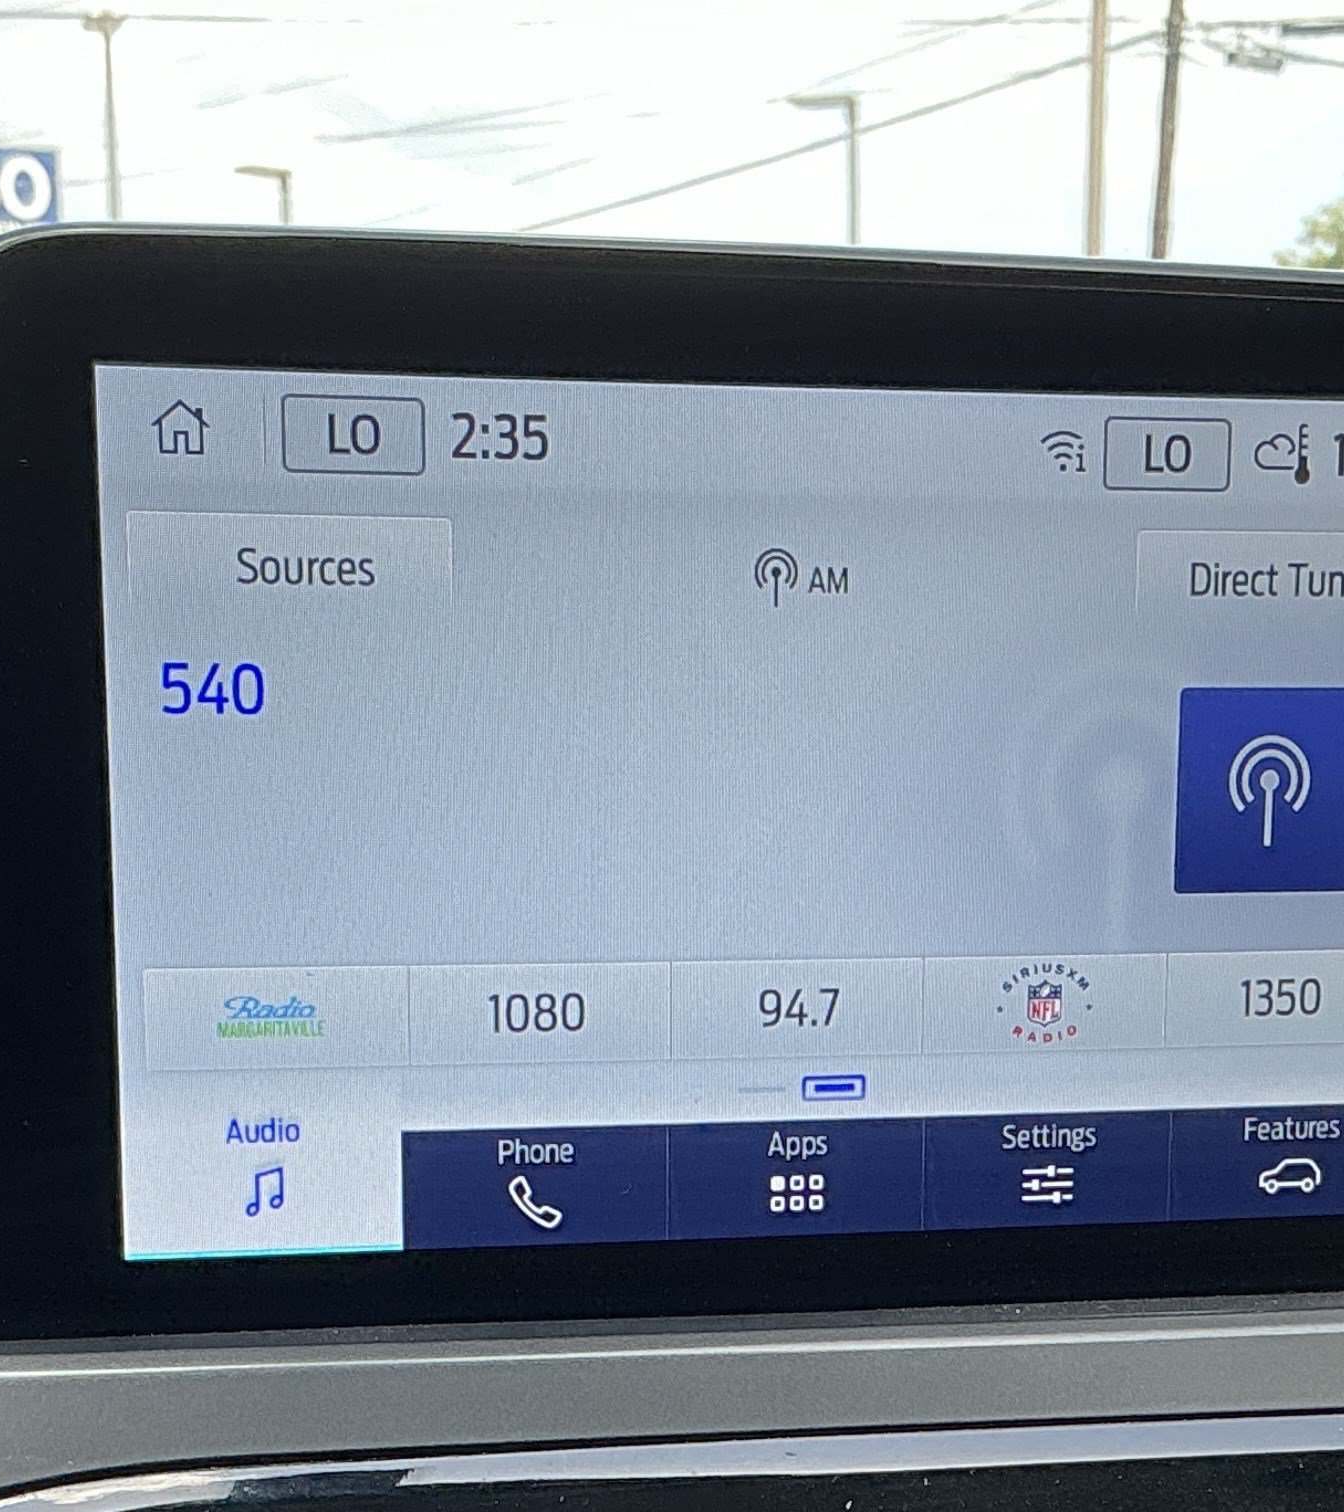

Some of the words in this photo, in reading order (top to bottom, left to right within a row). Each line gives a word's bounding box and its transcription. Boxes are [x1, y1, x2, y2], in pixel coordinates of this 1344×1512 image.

[327, 412, 381, 456] LO
[451, 412, 549, 461] 2:35
[1144, 434, 1192, 474] LO
[236, 547, 375, 587] Sources
[807, 566, 850, 595] AM
[1190, 562, 1280, 597] Direct
[161, 662, 265, 715] 540
[1002, 963, 1089, 993] SIRIUSXM
[223, 995, 316, 1019] Radio
[488, 992, 586, 1033] 1080
[758, 987, 840, 1028] 94.7
[1030, 1000, 1060, 1021] NFL
[1241, 978, 1322, 1018] 1350
[1012, 1025, 1077, 1043] RADIO
[225, 1116, 301, 1145] Audio
[1001, 1123, 1098, 1153] Settings
[1243, 1115, 1341, 1142] Features
[497, 1138, 575, 1166] Phone
[767, 1130, 829, 1161] Apps
